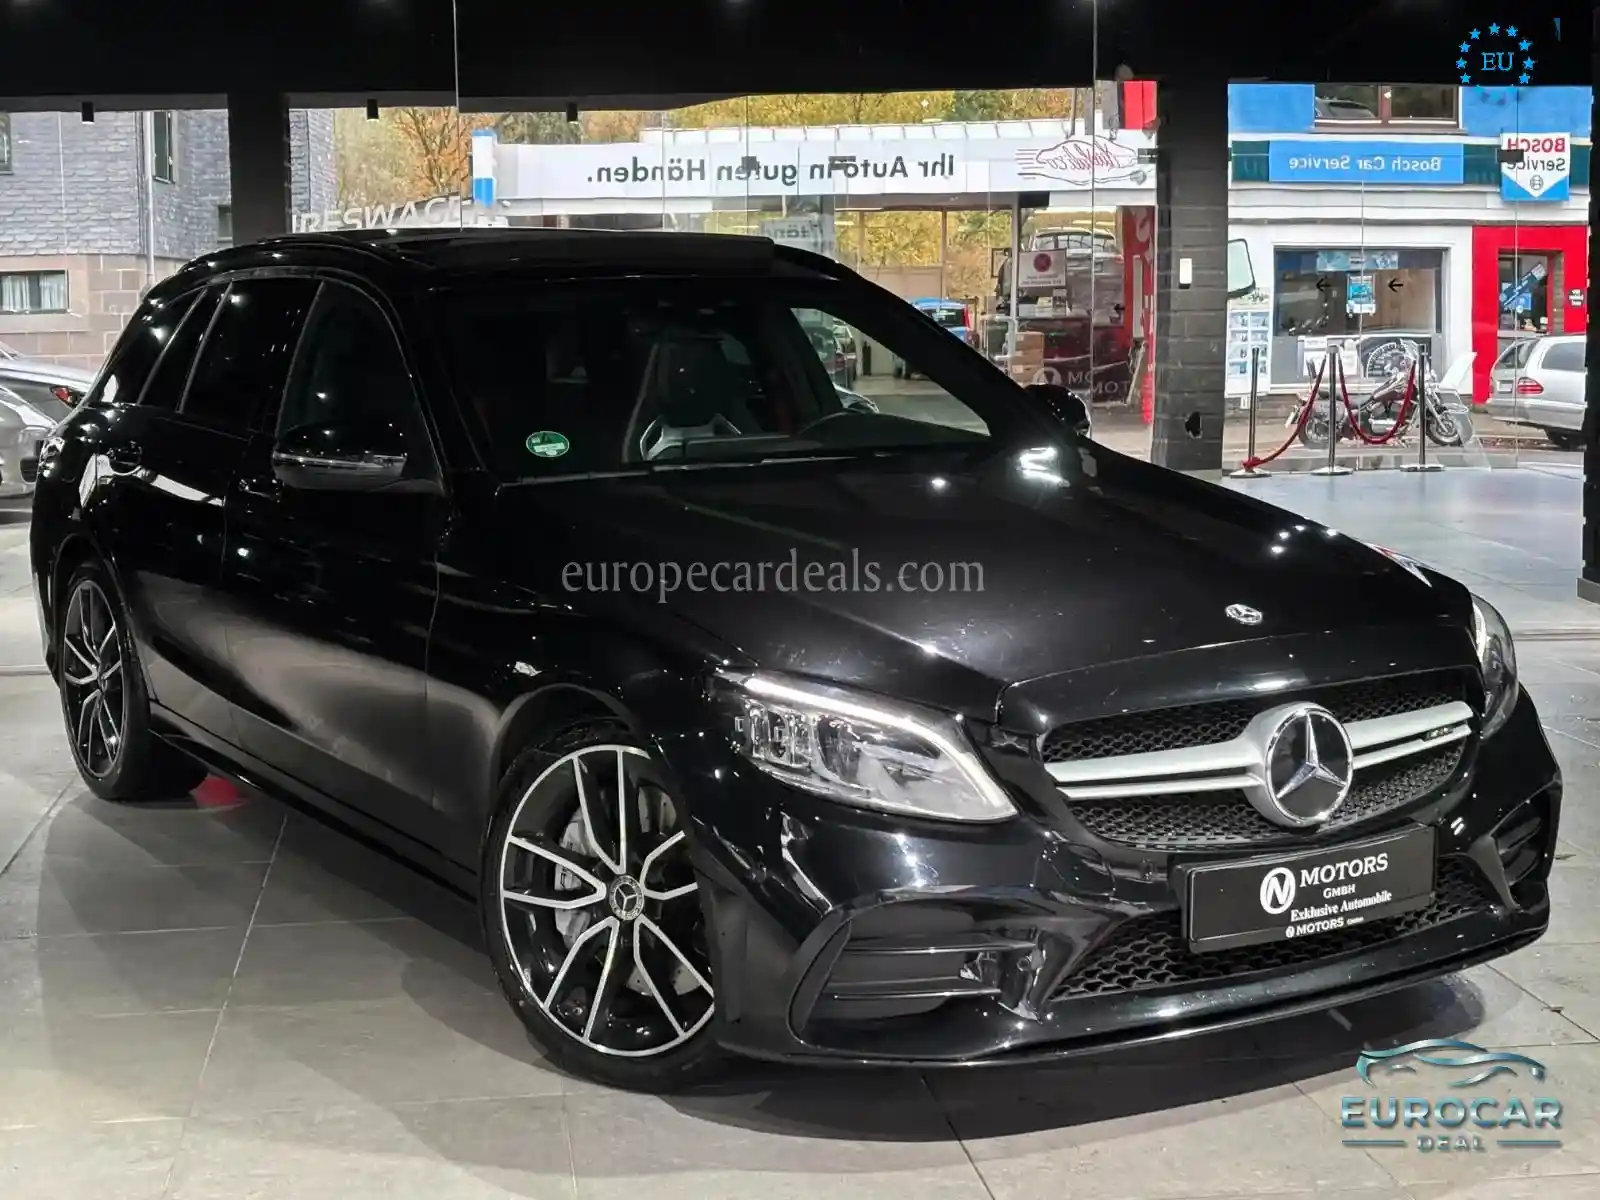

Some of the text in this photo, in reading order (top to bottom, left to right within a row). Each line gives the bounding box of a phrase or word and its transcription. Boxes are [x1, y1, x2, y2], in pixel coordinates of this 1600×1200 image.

[1300, 853, 1389, 887] MOTORS
[1323, 884, 1356, 899] GMBH
[1291, 904, 1338, 922] Exklusive
[1340, 890, 1392, 912] Automobile
[1296, 917, 1344, 936] MOTORS
